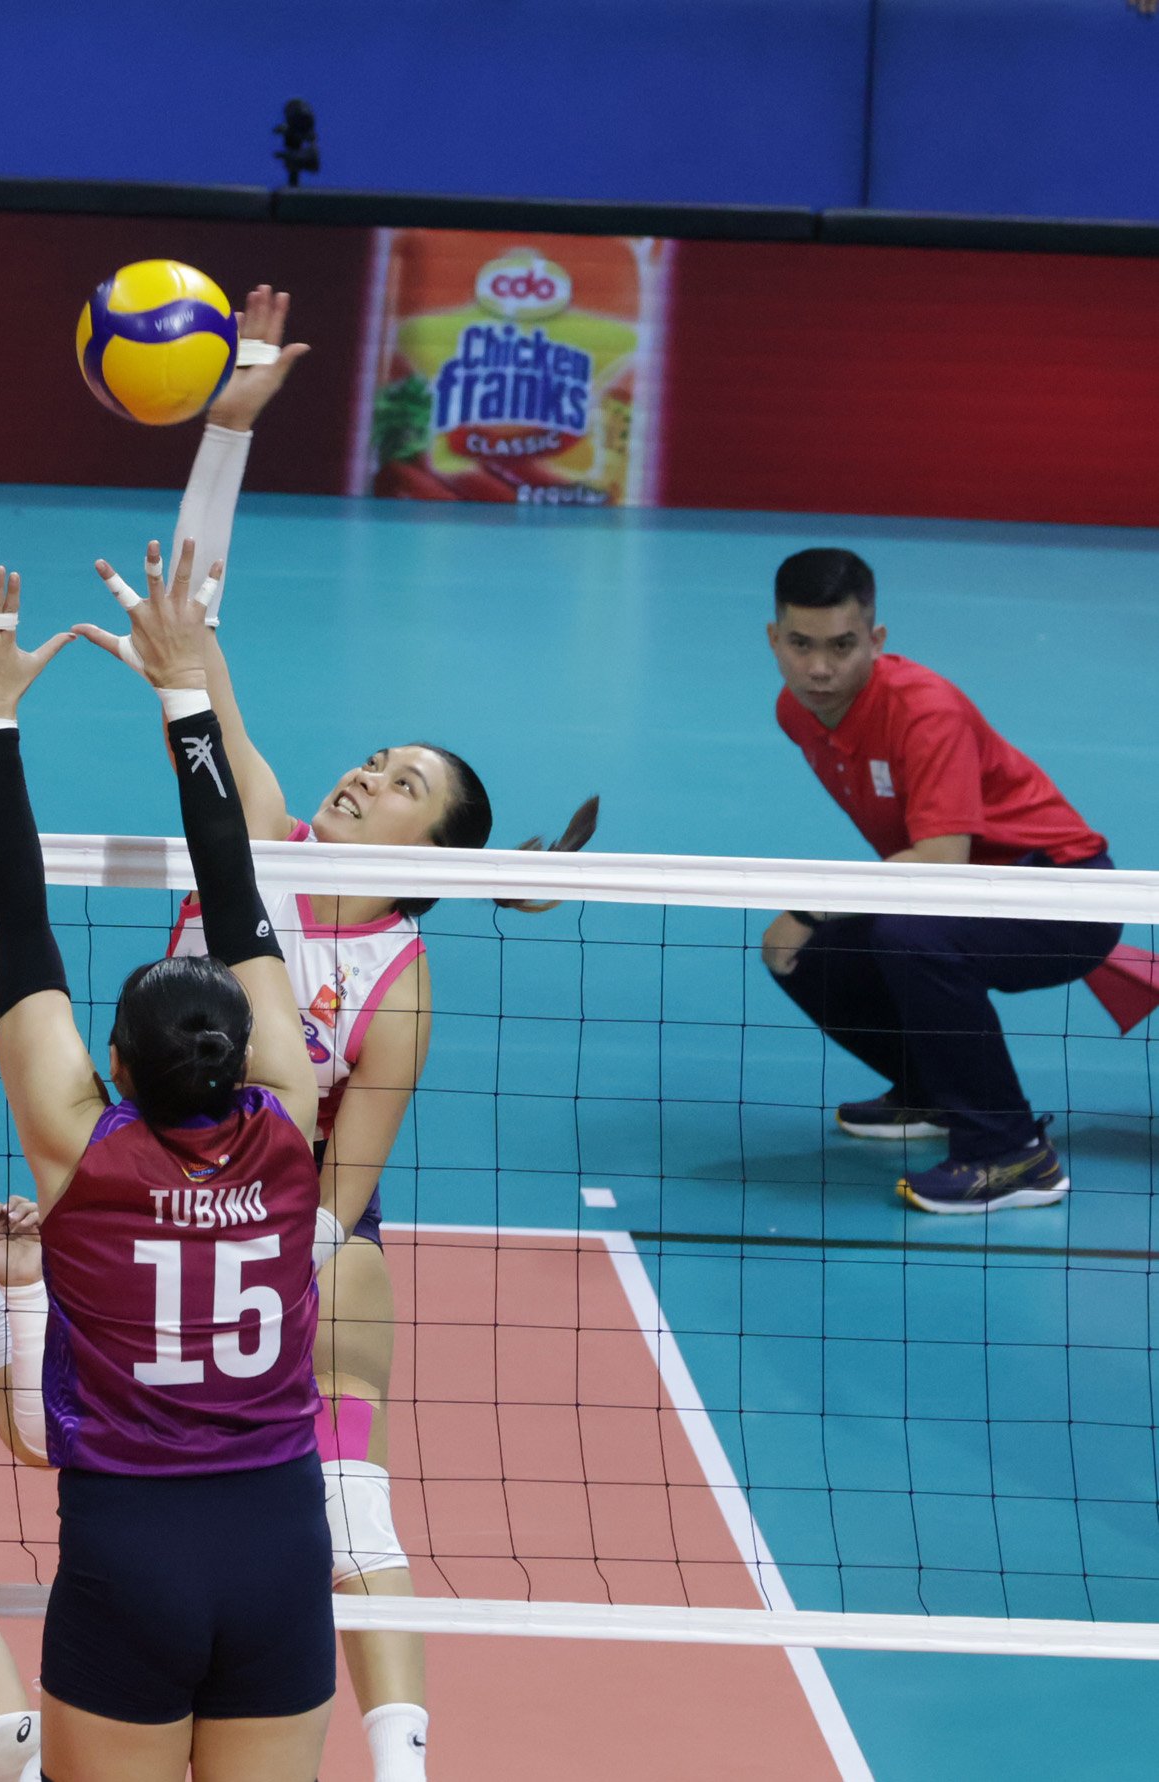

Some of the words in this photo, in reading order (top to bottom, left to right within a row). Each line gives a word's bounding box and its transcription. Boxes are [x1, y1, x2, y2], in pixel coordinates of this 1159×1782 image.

[491, 267, 555, 300] cdo
[464, 325, 589, 384] Chicken
[437, 359, 587, 430] franks
[466, 433, 561, 455] CLASSIC
[150, 1180, 267, 1228] TUBINO
[133, 1234, 283, 1385] 15
